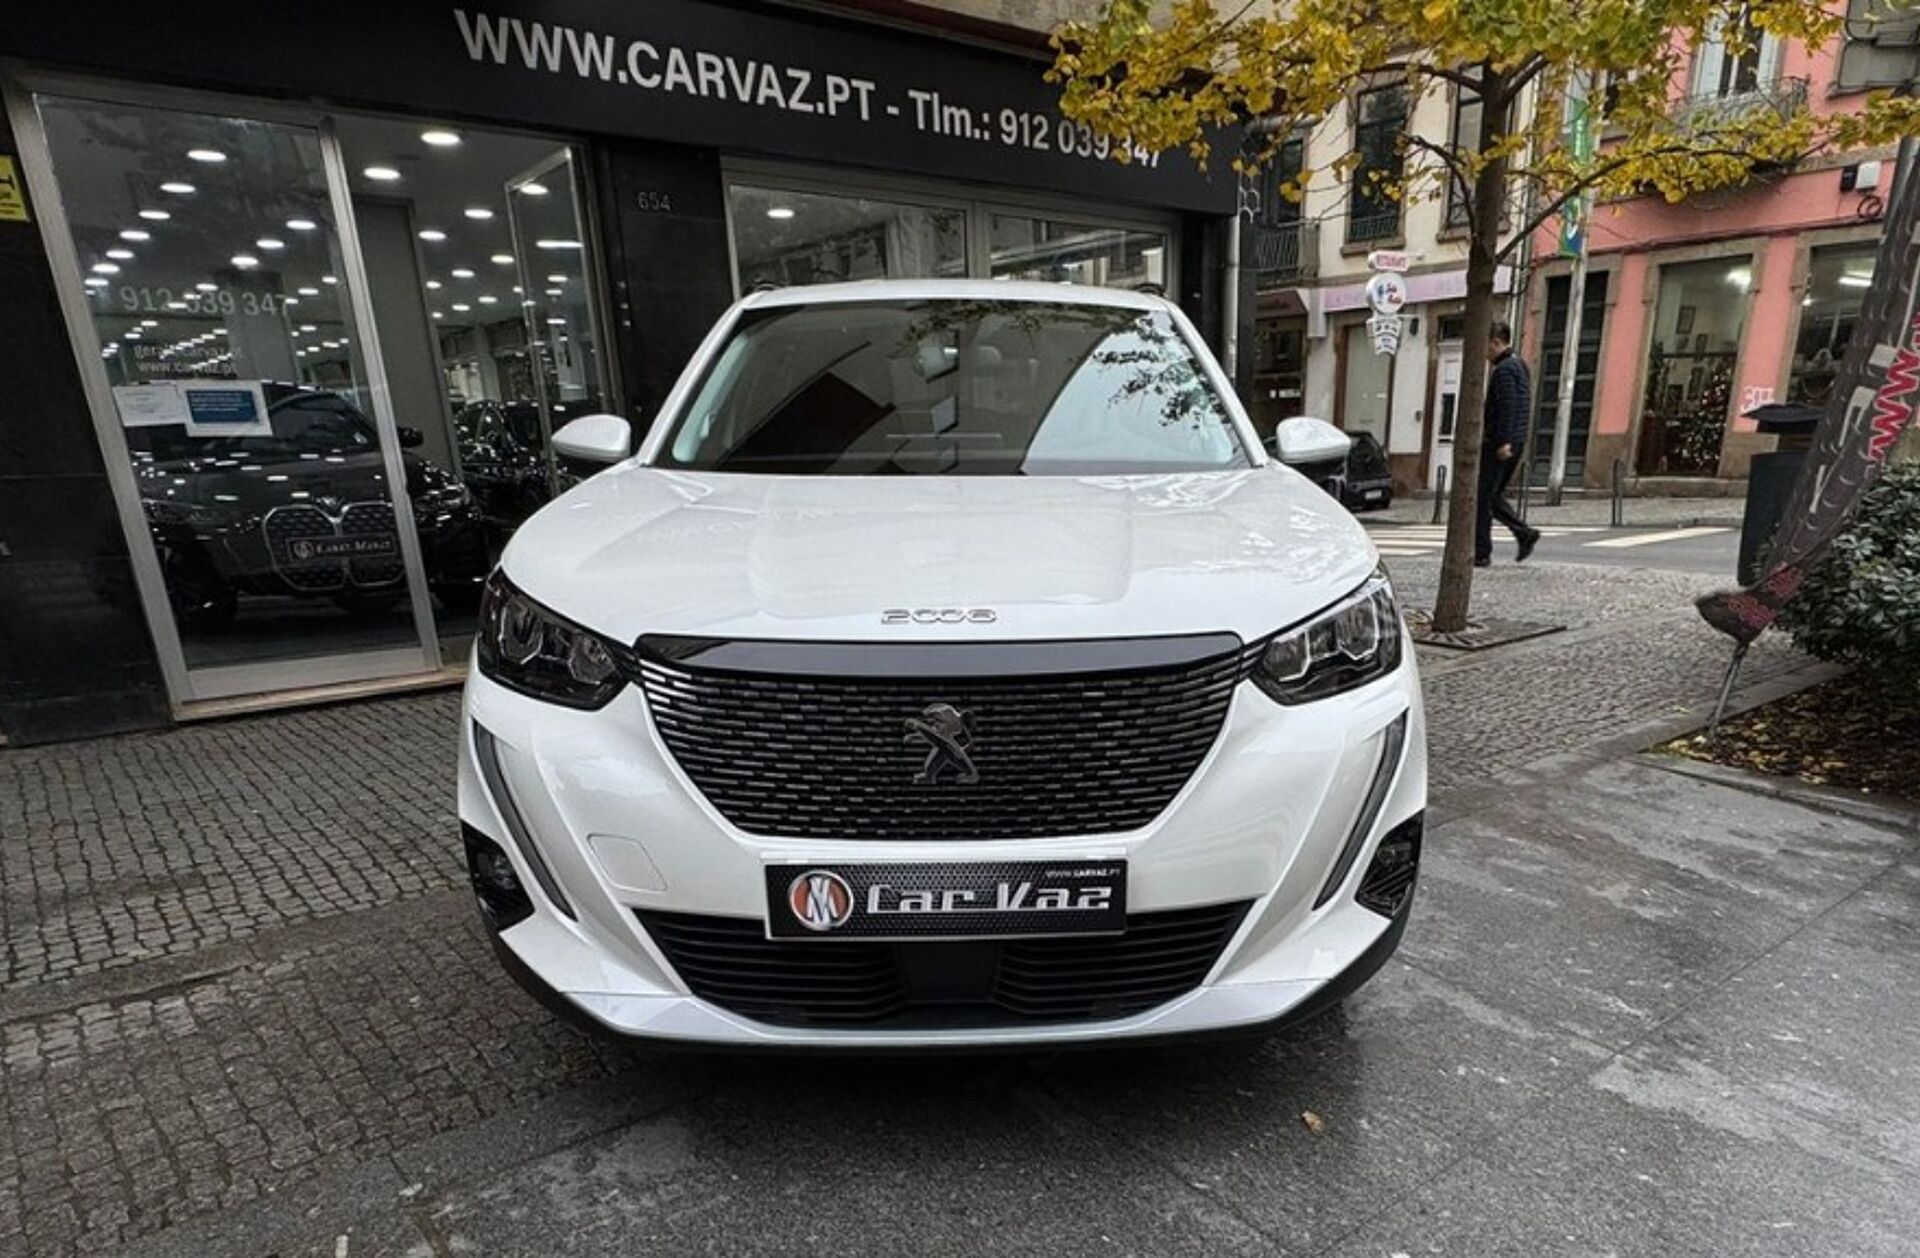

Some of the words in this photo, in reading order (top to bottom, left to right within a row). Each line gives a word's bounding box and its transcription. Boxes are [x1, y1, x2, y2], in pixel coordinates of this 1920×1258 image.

[453, 8, 876, 121] WWW.CARVAZ.PT
[907, 89, 990, 141] Tlm.:
[1000, 108, 1050, 150] 912
[1057, 120, 1110, 160] 039
[639, 191, 671, 211] 654
[121, 287, 172, 311] 912
[242, 292, 288, 317] 347
[881, 608, 997, 624] 2008
[867, 884, 974, 913] Car
[997, 882, 1111, 910] Vaz
